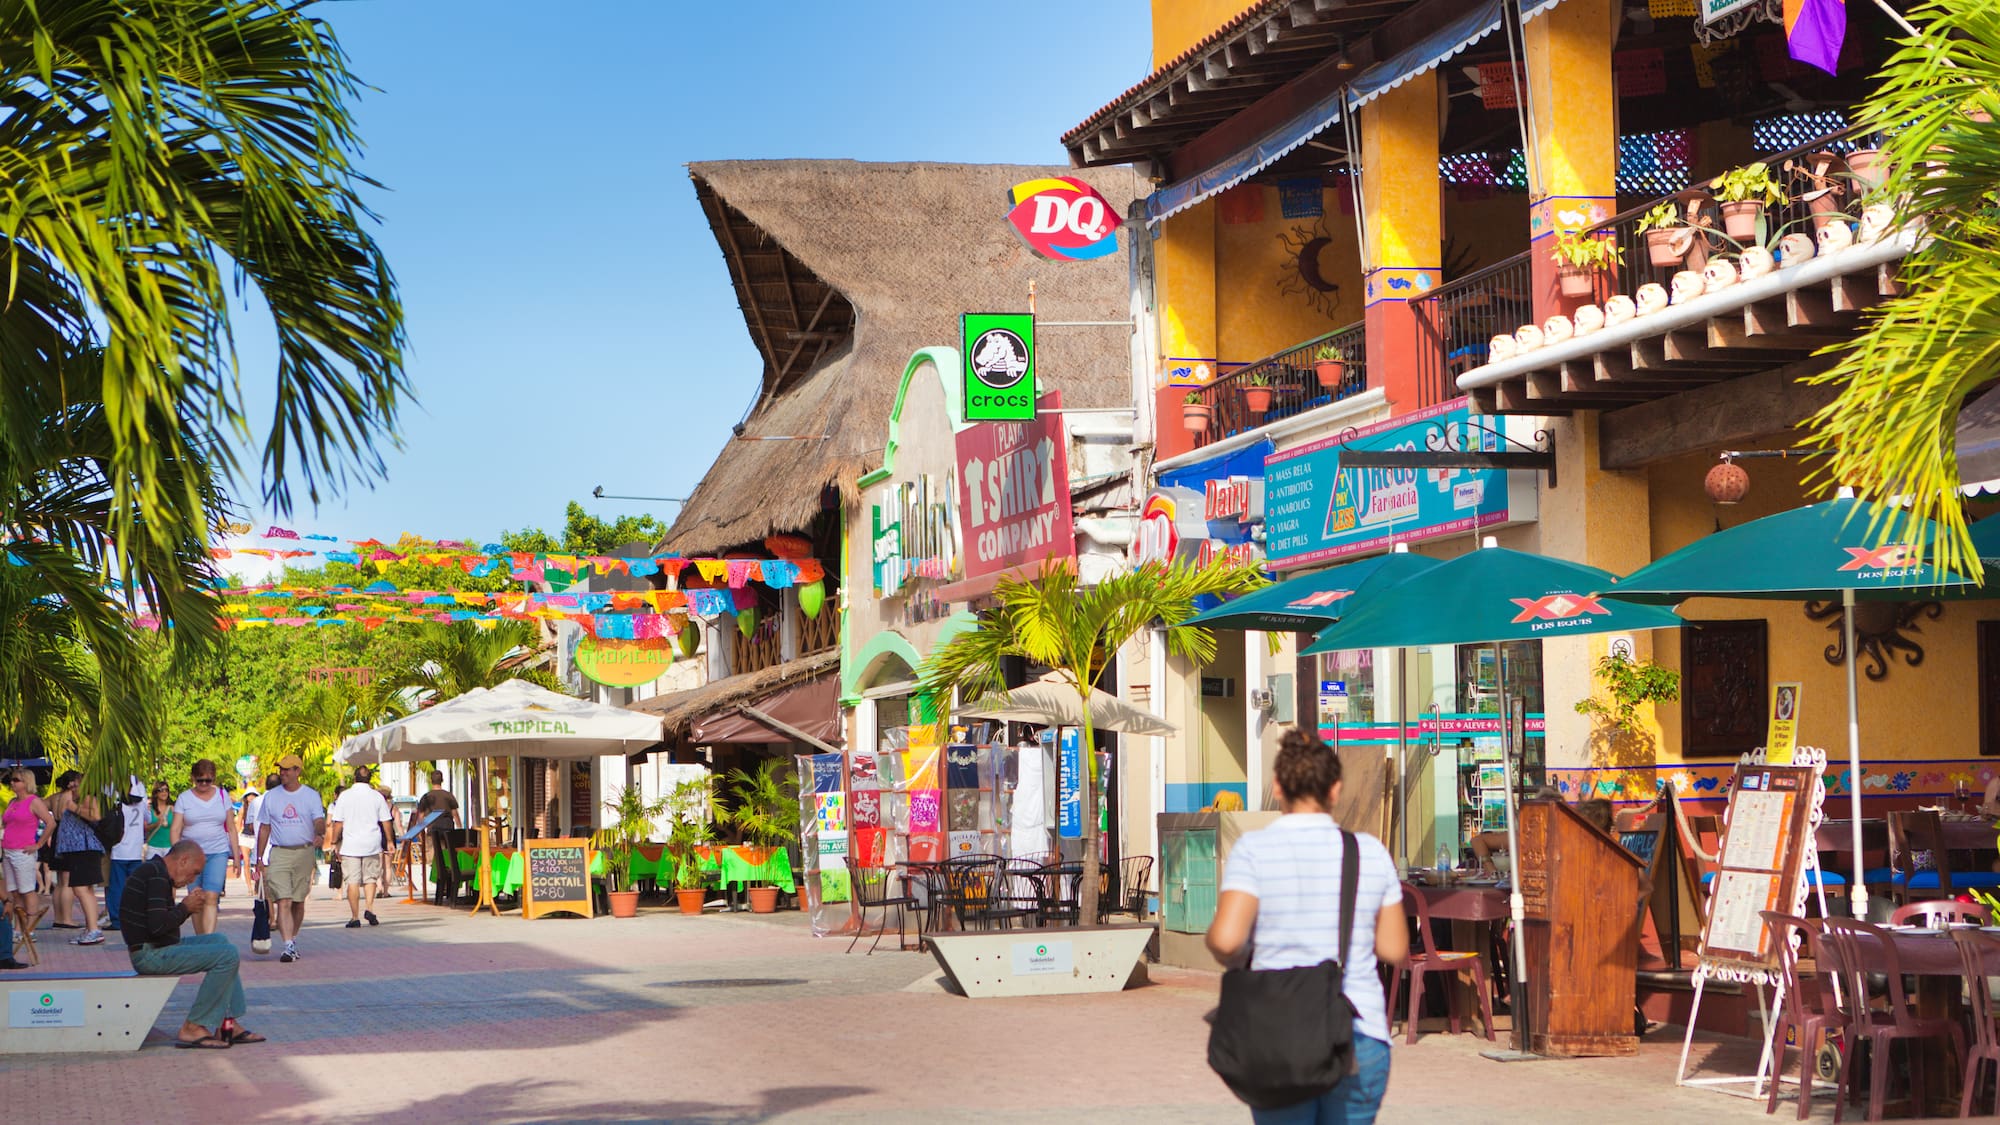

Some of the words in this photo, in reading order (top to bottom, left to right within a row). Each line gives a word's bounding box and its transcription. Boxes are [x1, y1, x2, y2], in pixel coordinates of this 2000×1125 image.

[1030, 195, 1104, 241] DQ
[972, 395, 1028, 407] crocs
[999, 423, 1024, 453] PLAYA
[1275, 467, 1292, 481] MASS
[1293, 463, 1312, 477] RELAX
[1276, 479, 1313, 498] ANTIBIOTICS
[1204, 475, 1249, 523] Dairy
[1277, 498, 1311, 516] ANABOLICS
[1277, 519, 1300, 534] VIAGRA
[1332, 506, 1355, 533] LESS
[978, 509, 1055, 562] COMPANY
[1277, 537, 1291, 551] DIET
[1292, 534, 1308, 547] PILLS
[1531, 621, 1554, 632] DOS
[1557, 618, 1593, 628] EQUIS
[582, 649, 669, 665] TROPICAL
[489, 720, 576, 735] TROPICAL
[1463, 721, 1487, 729] ALEVE
[129, 808, 139, 827] 2
[531, 848, 582, 859] CERVEZA
[832, 841, 848, 850] AVE
[532, 877, 584, 887] COCKTAIL
